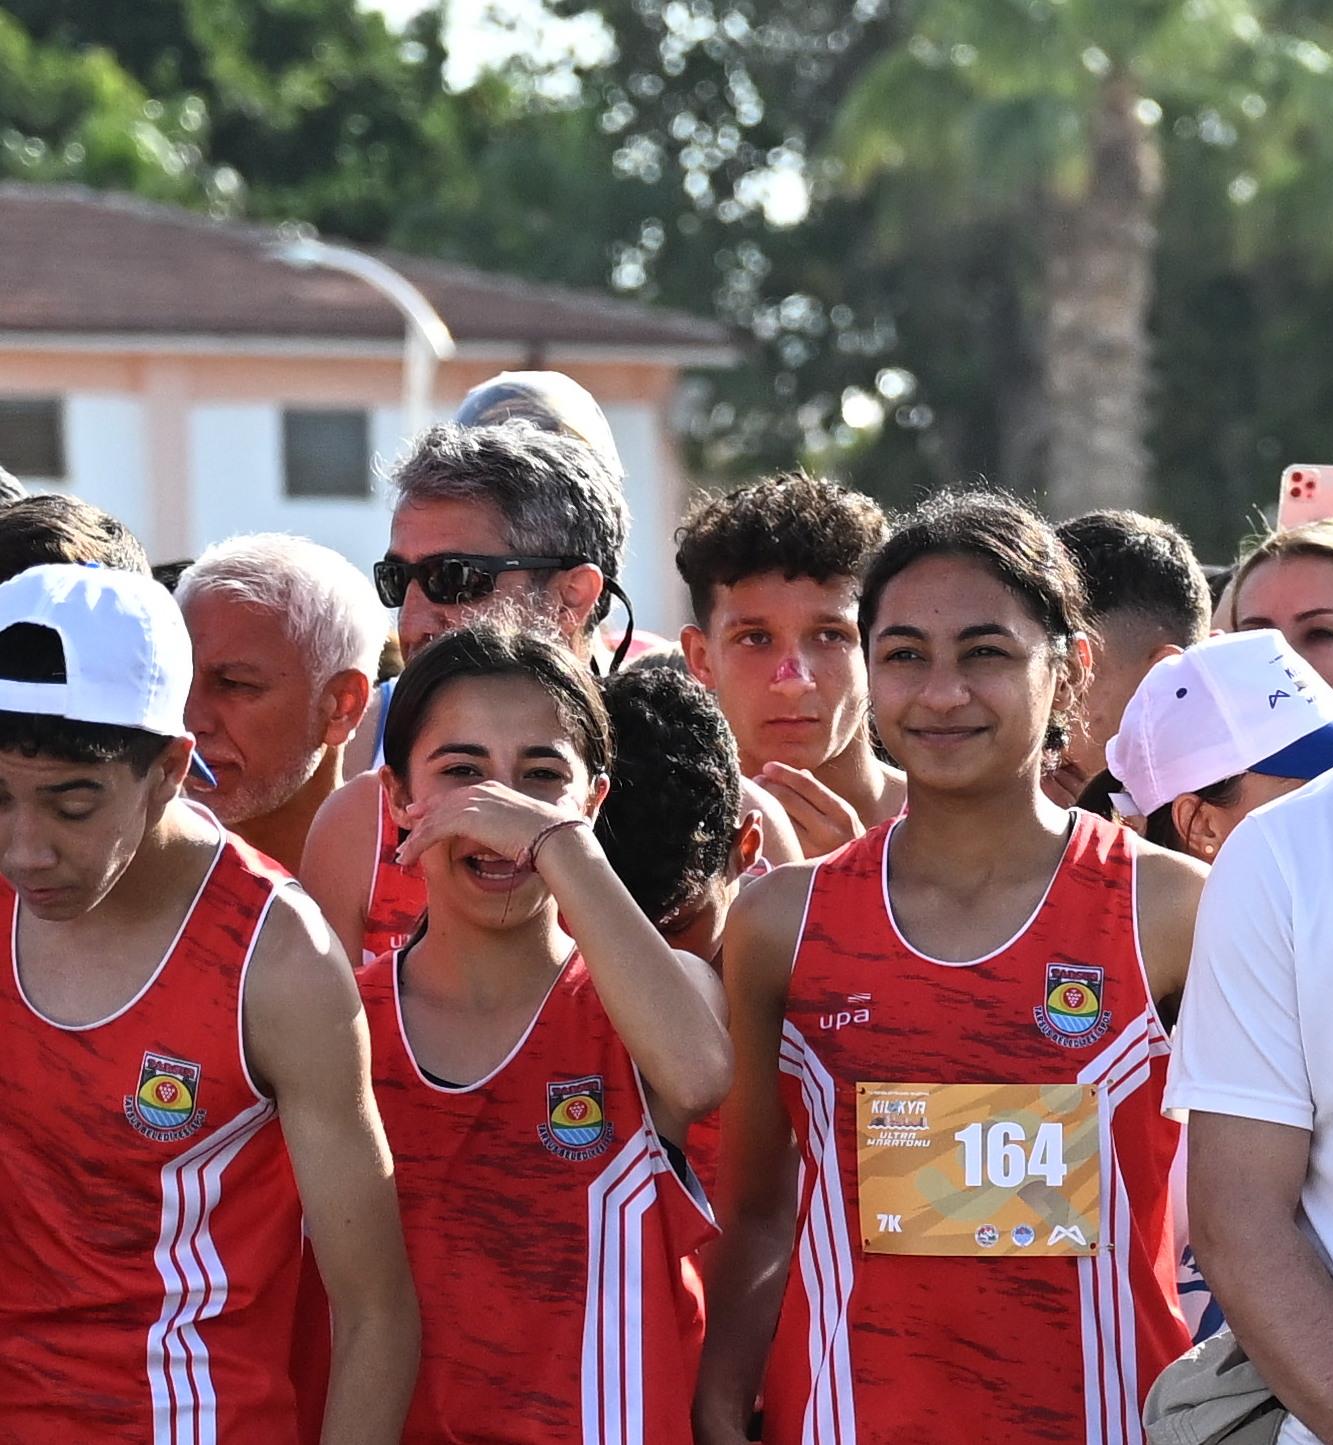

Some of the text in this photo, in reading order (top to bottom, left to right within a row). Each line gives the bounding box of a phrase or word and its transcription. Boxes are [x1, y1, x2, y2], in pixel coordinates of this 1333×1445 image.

[820, 1009, 870, 1031] upa
[866, 1138, 931, 1147] MARATONU
[879, 1131, 917, 1140] ULTRA
[954, 1121, 1068, 1188] 164
[876, 1214, 903, 1233] 7K
